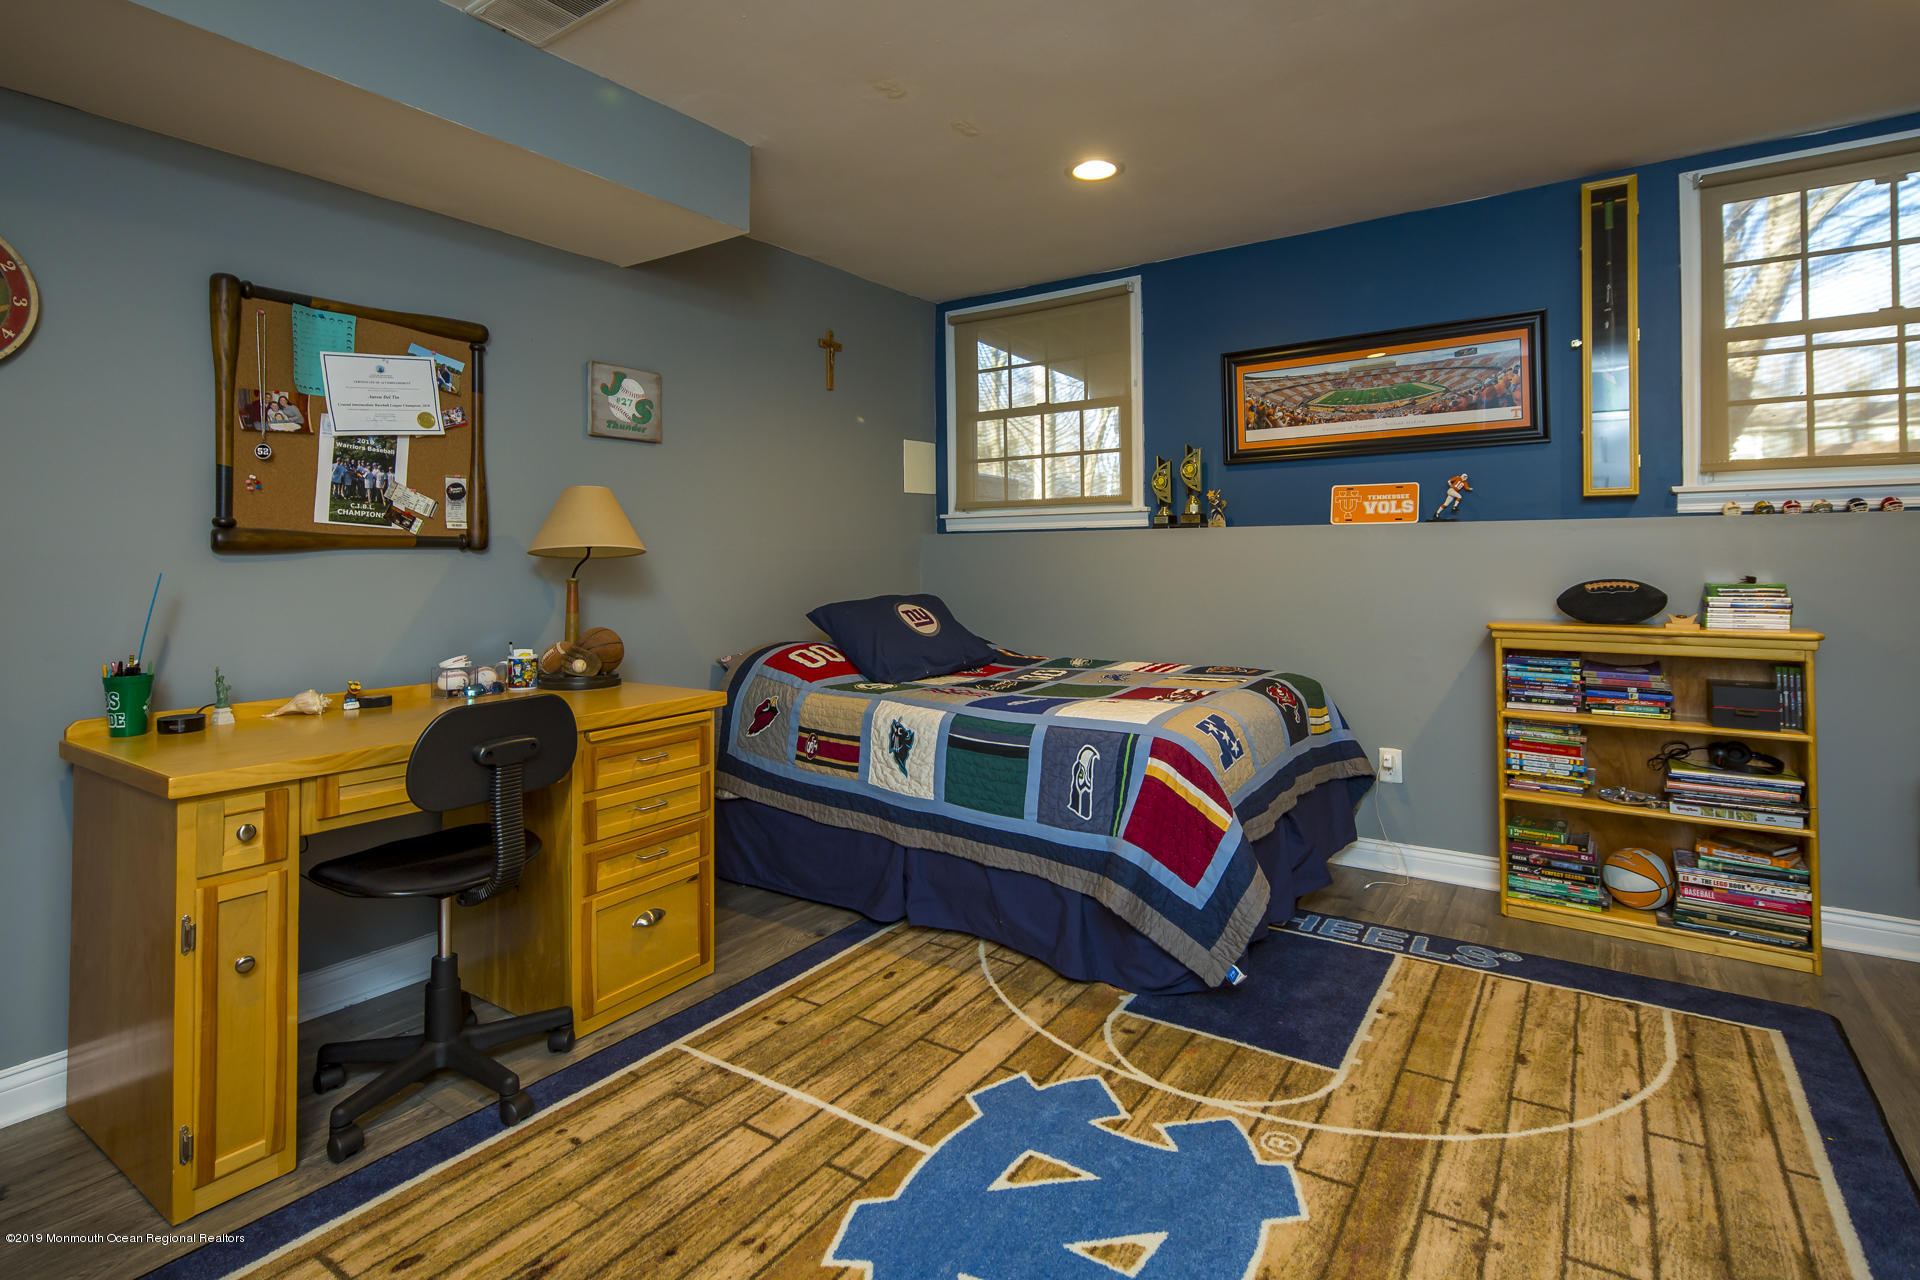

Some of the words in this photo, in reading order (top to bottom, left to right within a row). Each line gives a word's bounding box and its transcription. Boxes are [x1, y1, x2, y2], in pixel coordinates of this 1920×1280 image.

[0, 260, 16, 272] 2
[13, 295, 28, 307] 3
[1, 327, 16, 340] 4
[632, 398, 654, 425] S
[606, 420, 648, 433] Thunder
[256, 447, 269, 456] 52
[336, 441, 366, 451] Warriors
[367, 445, 395, 455] Baseball
[1368, 493, 1411, 501] TENNESSEE
[1363, 499, 1415, 515] VOLS
[787, 644, 846, 669] 00
[1729, 882, 1746, 890] BOOK
[1684, 887, 1715, 898] BASEBALL
